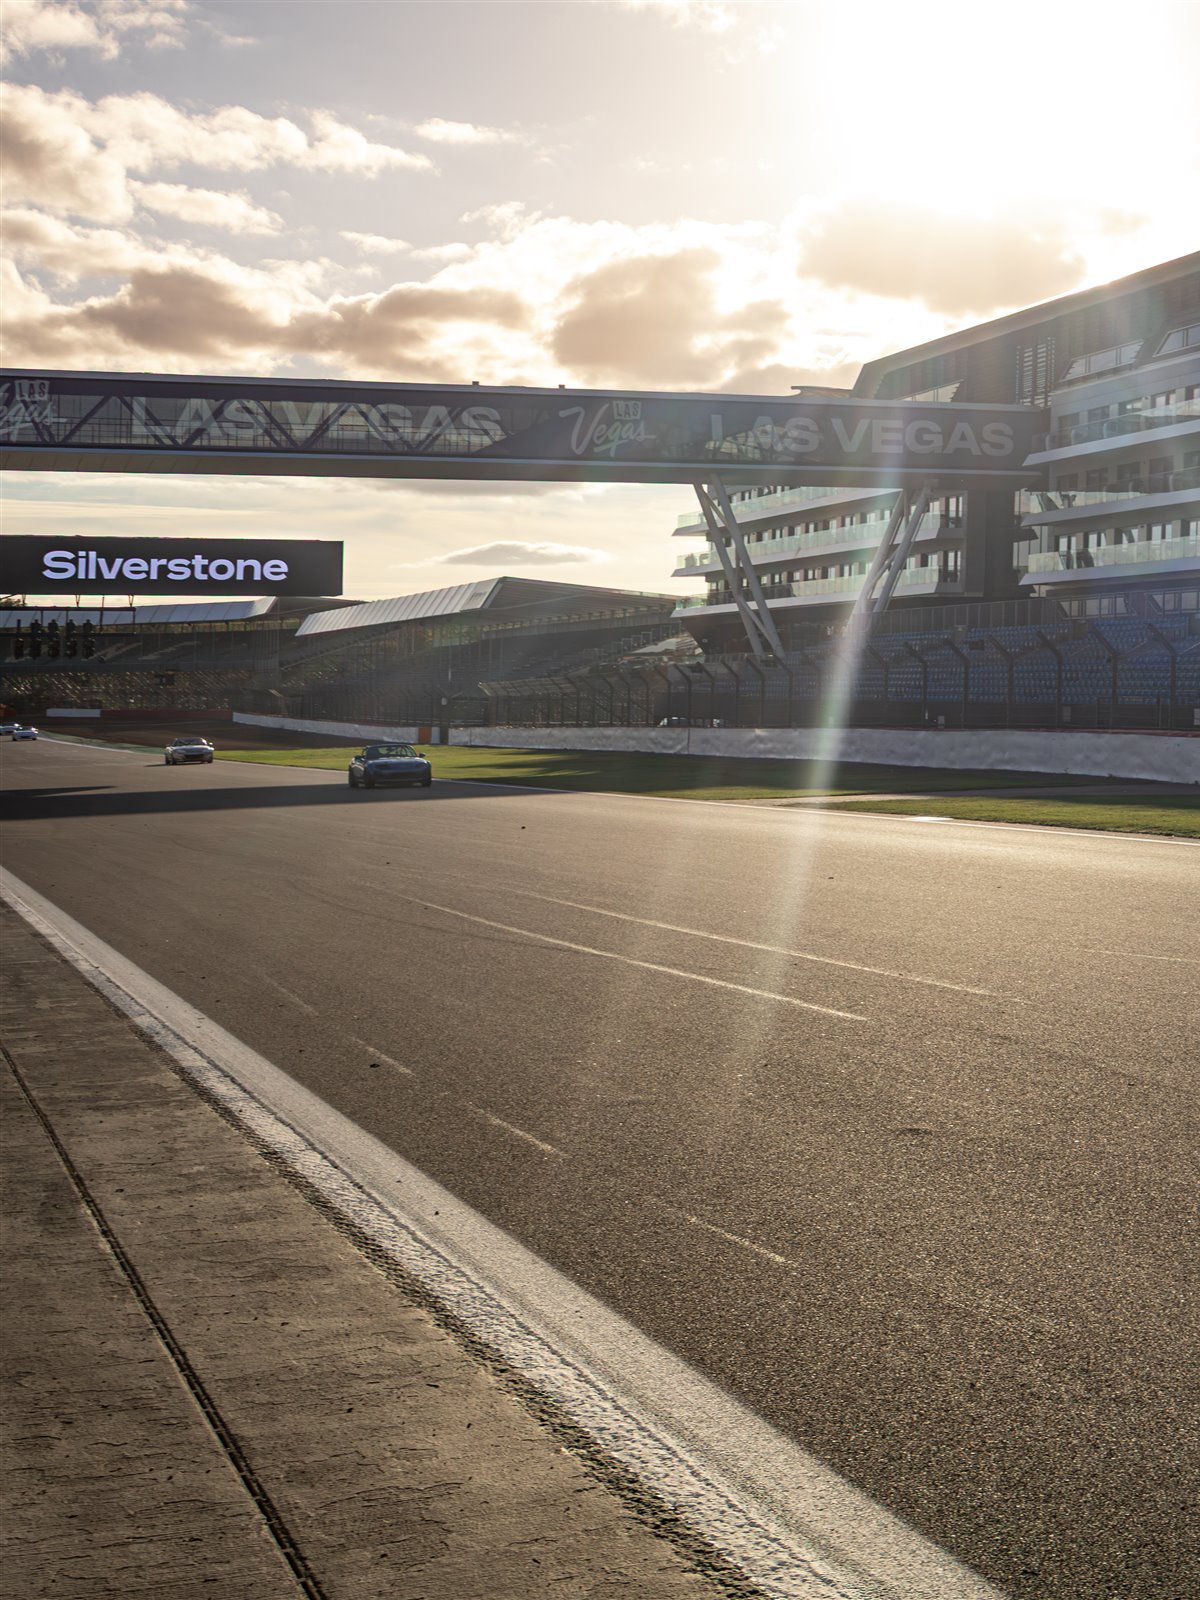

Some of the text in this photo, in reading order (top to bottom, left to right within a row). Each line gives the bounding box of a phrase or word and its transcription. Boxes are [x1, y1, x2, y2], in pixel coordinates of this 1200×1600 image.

[18, 381, 47, 399] LAS
[132, 396, 273, 439] LAS
[615, 402, 640, 418] LAS
[559, 403, 656, 457] Vegas
[710, 414, 1014, 457] LAS VEGAS
[42, 550, 289, 581] Silverstone
